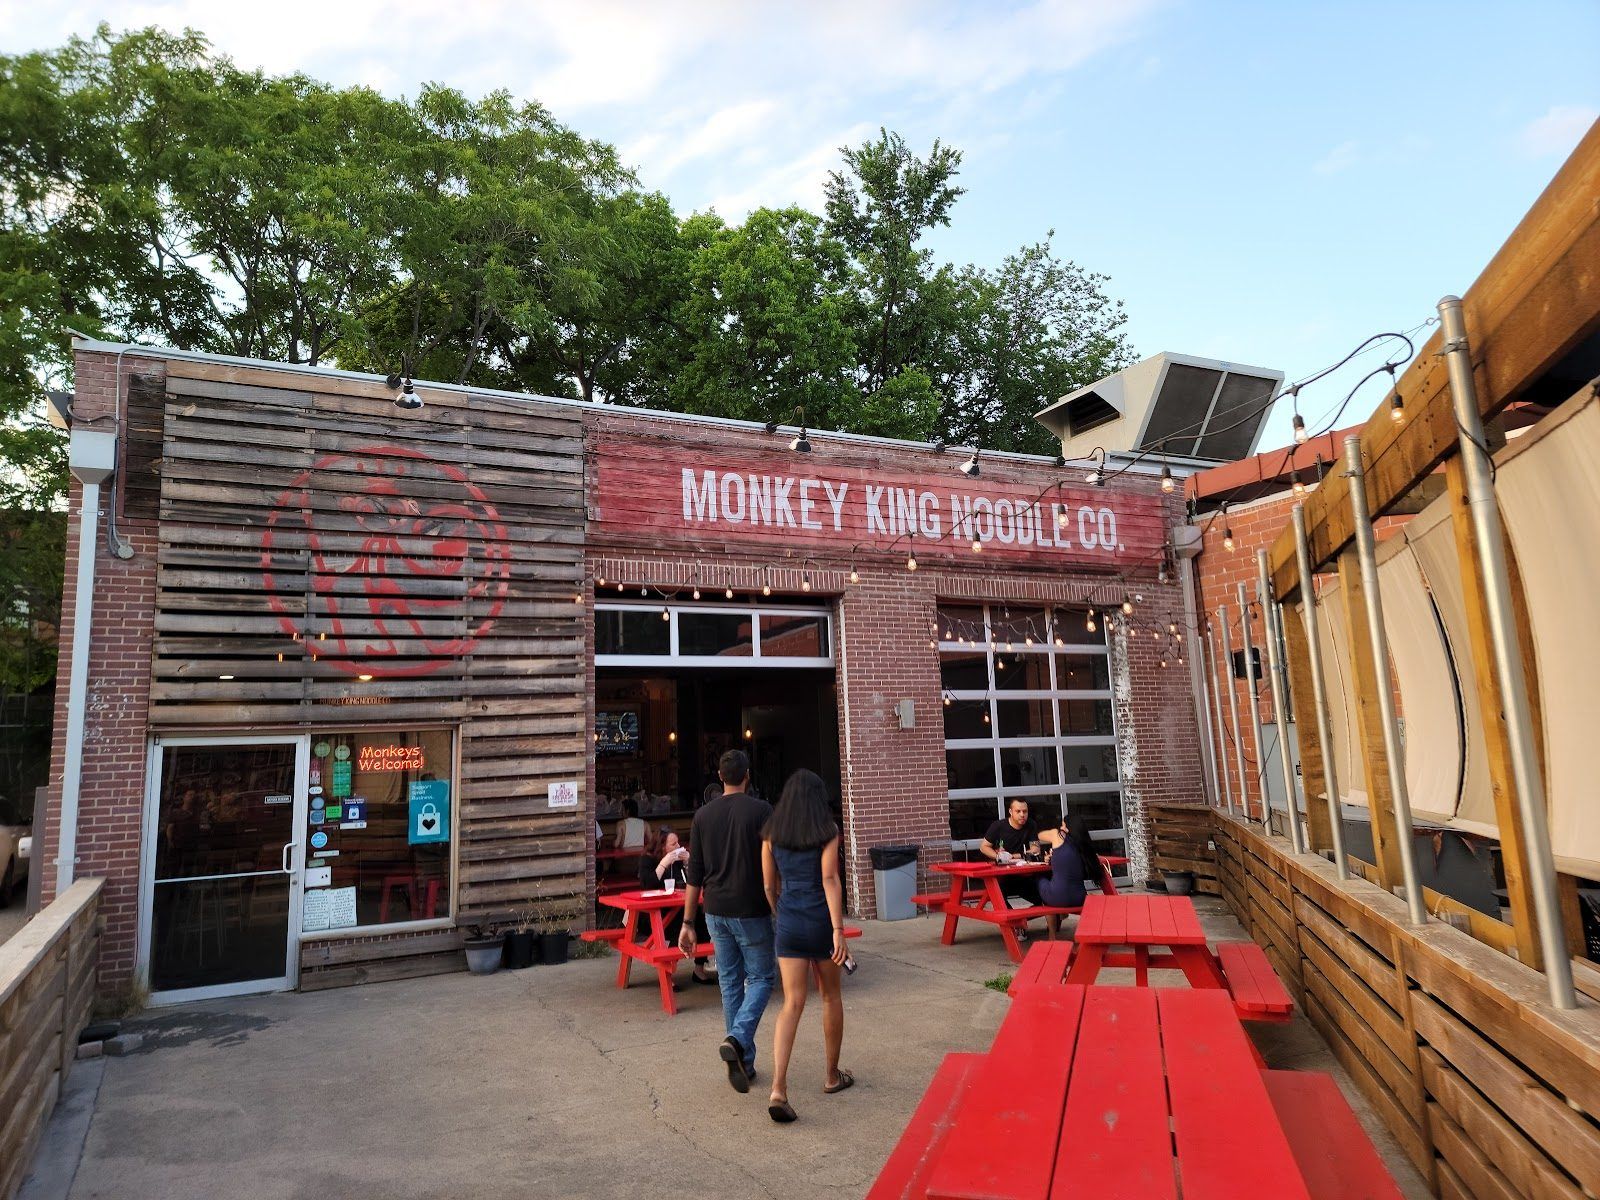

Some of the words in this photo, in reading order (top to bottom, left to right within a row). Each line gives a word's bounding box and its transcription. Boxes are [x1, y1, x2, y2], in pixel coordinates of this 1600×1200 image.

[681, 467, 849, 531] MONKEY
[865, 485, 941, 539] KING
[950, 494, 1072, 549] NOODLE
[1078, 505, 1126, 552] CO.
[361, 745, 420, 759] Monkeys
[359, 756, 424, 770] Welcome!
